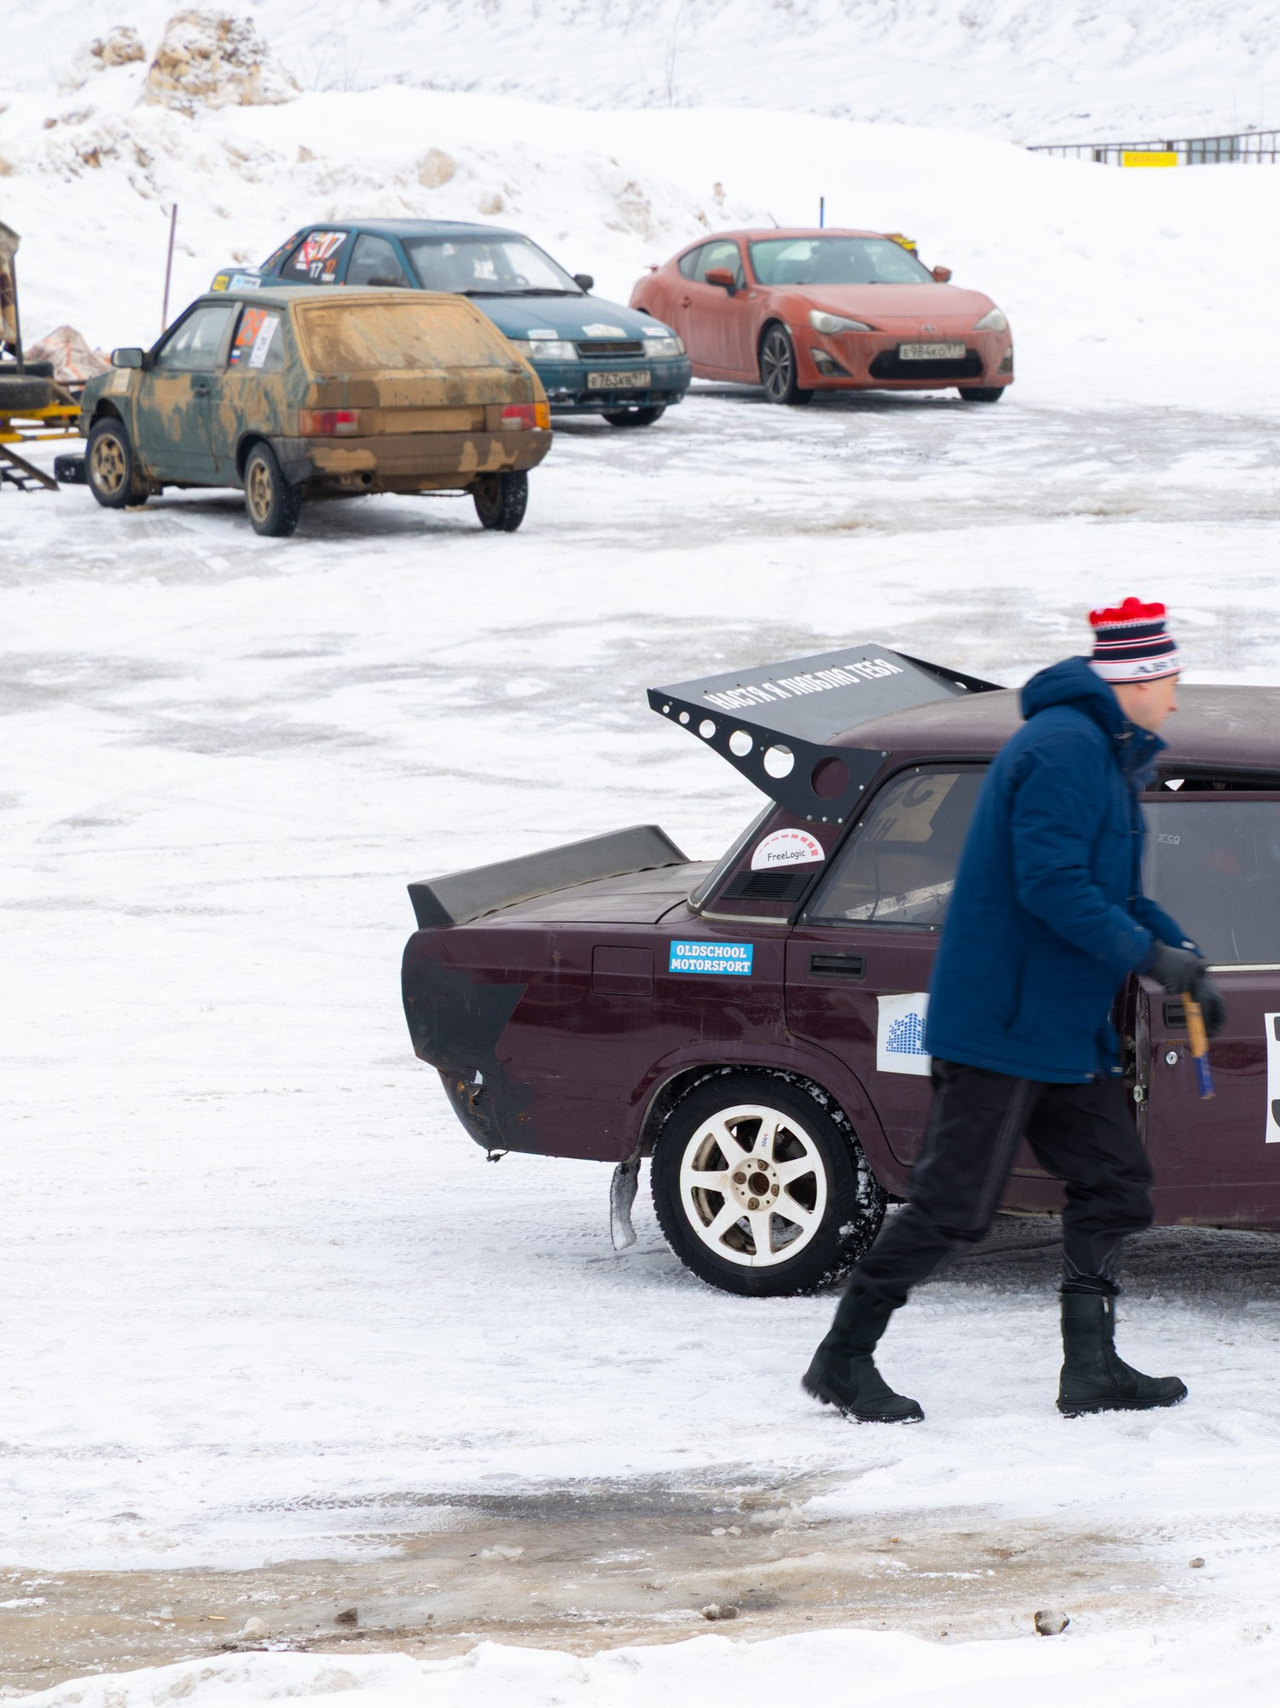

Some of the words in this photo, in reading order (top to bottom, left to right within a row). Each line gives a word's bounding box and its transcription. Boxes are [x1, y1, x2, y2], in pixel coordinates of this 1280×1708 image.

[843, 658, 904, 680] ТЕБЯ
[776, 668, 860, 695] ЛЮБЛЮ
[702, 686, 777, 710] НАСТЯ
[761, 682, 793, 699] Я
[767, 849, 806, 862] FreeLogic
[676, 944, 748, 959] OLDSCHOOL
[670, 958, 751, 973] MOTORSPORT
